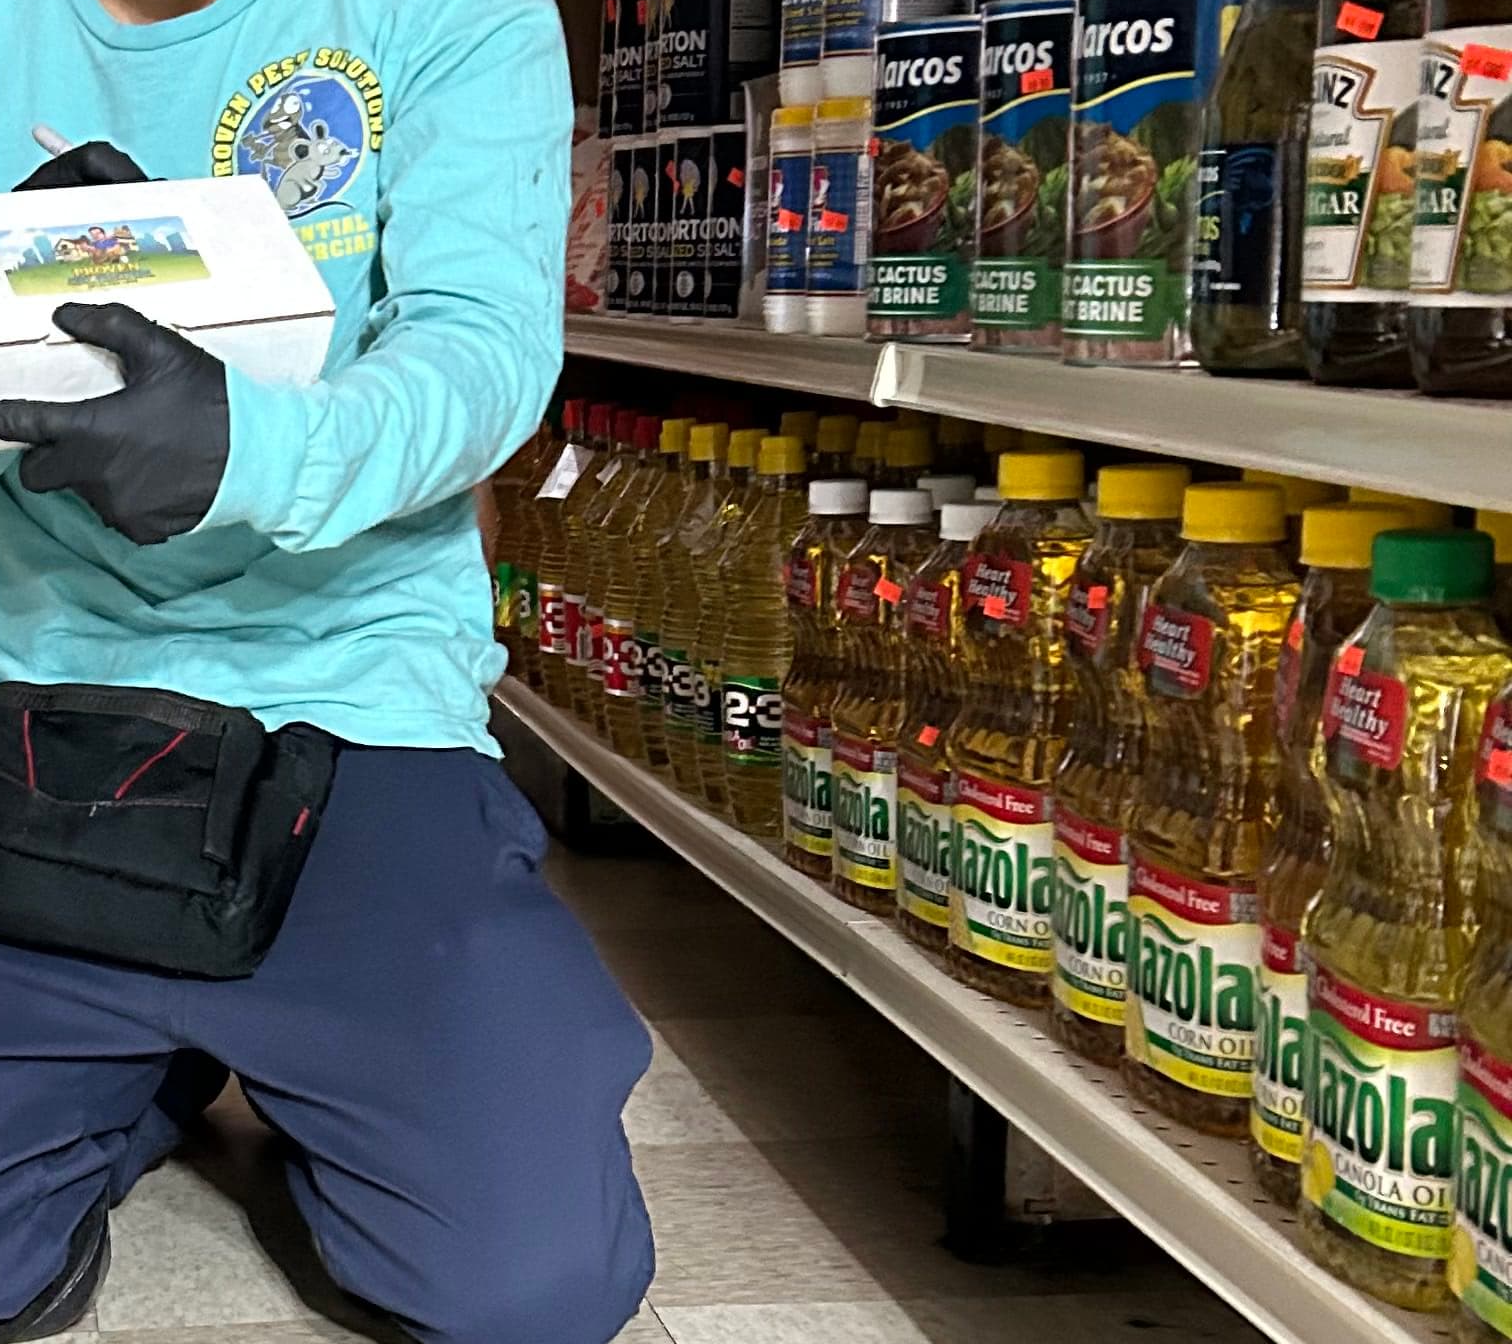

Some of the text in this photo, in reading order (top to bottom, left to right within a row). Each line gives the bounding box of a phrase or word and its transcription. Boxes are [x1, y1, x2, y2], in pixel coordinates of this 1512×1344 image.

[1077, 16, 1175, 59] arcos
[615, 46, 643, 67] TON
[673, 54, 707, 68] SALT
[983, 40, 1054, 76] arcos
[877, 54, 964, 90] arcos
[212, 91, 251, 177] ROVEN
[247, 47, 312, 98] PEST
[296, 214, 369, 243] NTIAL
[877, 265, 947, 285] CACTUS
[973, 270, 1037, 291] CACTUS
[1073, 274, 1153, 297] CACTUS
[882, 287, 940, 305] BRINE
[977, 294, 1029, 313] BRINE
[1078, 300, 1144, 322] BRINE
[977, 563, 1012, 583] Heart
[968, 578, 1018, 605] Healthy
[1151, 615, 1191, 639] Heart
[1143, 634, 1195, 667] Healthy
[1339, 676, 1382, 706] Heart
[1330, 700, 1390, 737] Healthy
[833, 772, 889, 840] azola
[1005, 794, 1035, 814] Free
[899, 802, 951, 876] azola
[952, 819, 1056, 914] azola
[1189, 891, 1221, 913] Free
[987, 910, 1050, 936] CORN O
[1108, 970, 1125, 986] O
[1129, 916, 1254, 1032] azola
[1168, 1021, 1213, 1051] CORN
[1373, 1007, 1416, 1038] Free
[1307, 1027, 1460, 1178] azola
[1336, 1153, 1447, 1208] CANOLA OI
[1409, 1207, 1437, 1224] FAT
